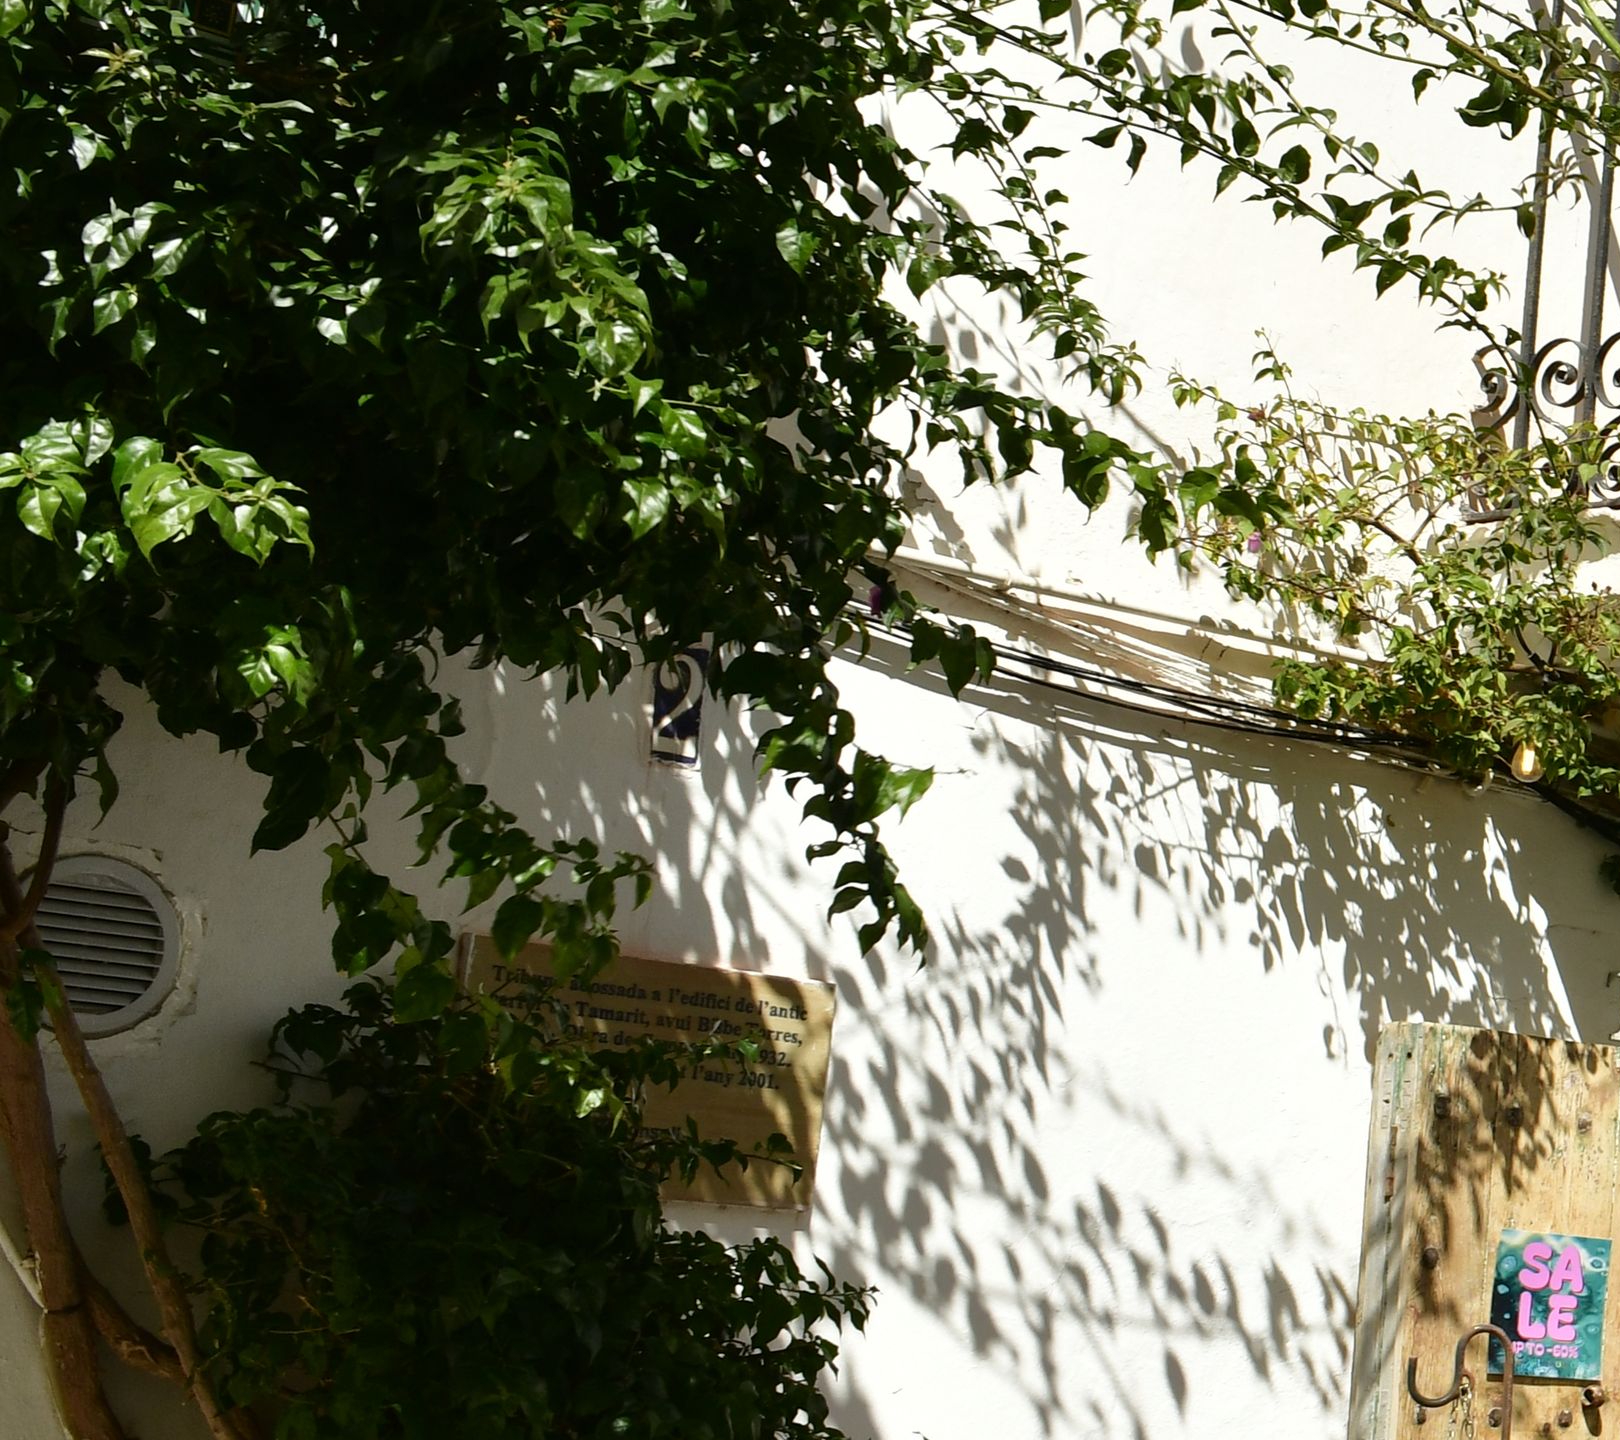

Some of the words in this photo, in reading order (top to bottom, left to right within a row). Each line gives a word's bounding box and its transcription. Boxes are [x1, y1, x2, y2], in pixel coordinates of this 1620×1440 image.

[570, 975, 647, 999] aossada
[668, 988, 730, 1010] l'edifici
[734, 998, 756, 1014] de
[758, 1000, 808, 1021] l'antic
[575, 1001, 650, 1027] Tamarit,
[656, 1014, 692, 1031] avui
[757, 1049, 792, 1068] 932.
[691, 1064, 734, 1087] l'any
[1518, 1241, 1584, 1293] SA
[1517, 1290, 1578, 1342] LE
[1525, 1342, 1545, 1356] TO
